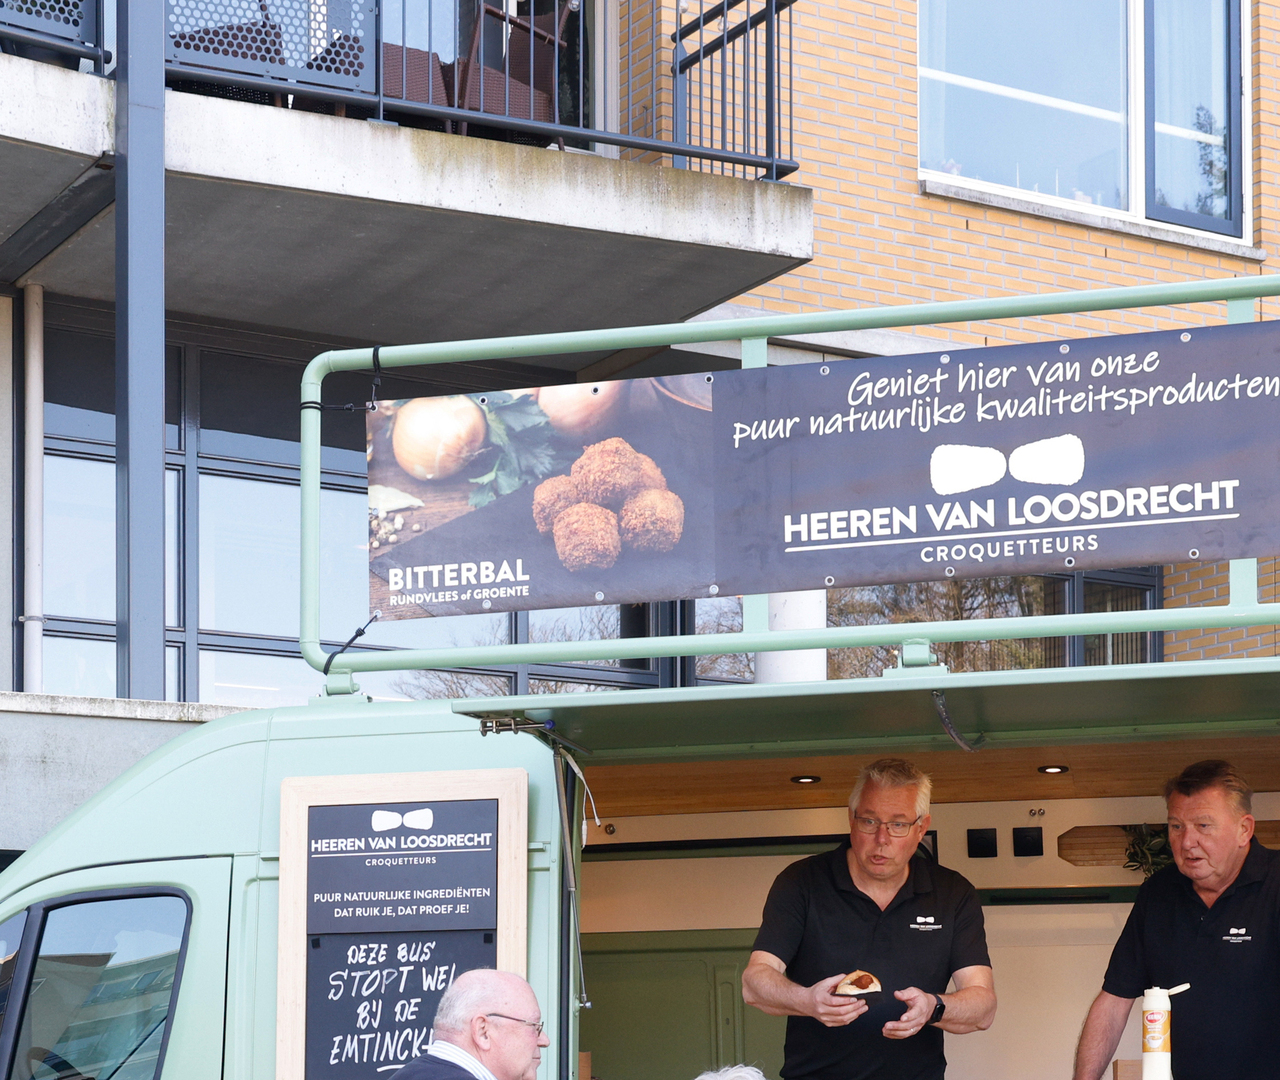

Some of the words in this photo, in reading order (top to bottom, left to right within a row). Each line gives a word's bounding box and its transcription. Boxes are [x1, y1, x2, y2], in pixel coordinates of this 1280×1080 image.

[847, 367, 949, 407] Geniet
[958, 362, 1017, 393] hier
[1026, 361, 1080, 387] van
[1090, 350, 1160, 378] onze
[732, 416, 800, 448] puur
[809, 397, 966, 436] natuurlijke
[784, 505, 917, 542] HEEREN
[925, 499, 995, 531] VAN
[1009, 479, 1240, 527] LOOSDRECHT
[920, 534, 1099, 563] CROQUETTEURS
[388, 559, 530, 591] BITTERBAL
[389, 591, 459, 606] RUNDVLEES
[460, 590, 472, 600] of
[473, 585, 529, 599] GROENTE
[311, 836, 365, 852] HEEREN
[368, 836, 396, 850] VAN
[401, 833, 492, 849] LOOSDRECHT
[365, 856, 437, 867] CROQUETTEURS
[314, 892, 341, 902] PUUR
[343, 890, 411, 901] NATUURLIJKE
[413, 887, 490, 899] INGREDIËNTEN
[334, 907, 354, 917] DAT
[356, 907, 380, 917] RUIK
[381, 906, 396, 918] JE,
[398, 905, 417, 916] DAT
[419, 905, 454, 915] PROEF
[454, 904, 469, 914] JE!
[347, 944, 388, 965] DEZE
[397, 941, 436, 963] BUS
[328, 966, 414, 1000] STOPT
[394, 998, 421, 1022] DE
